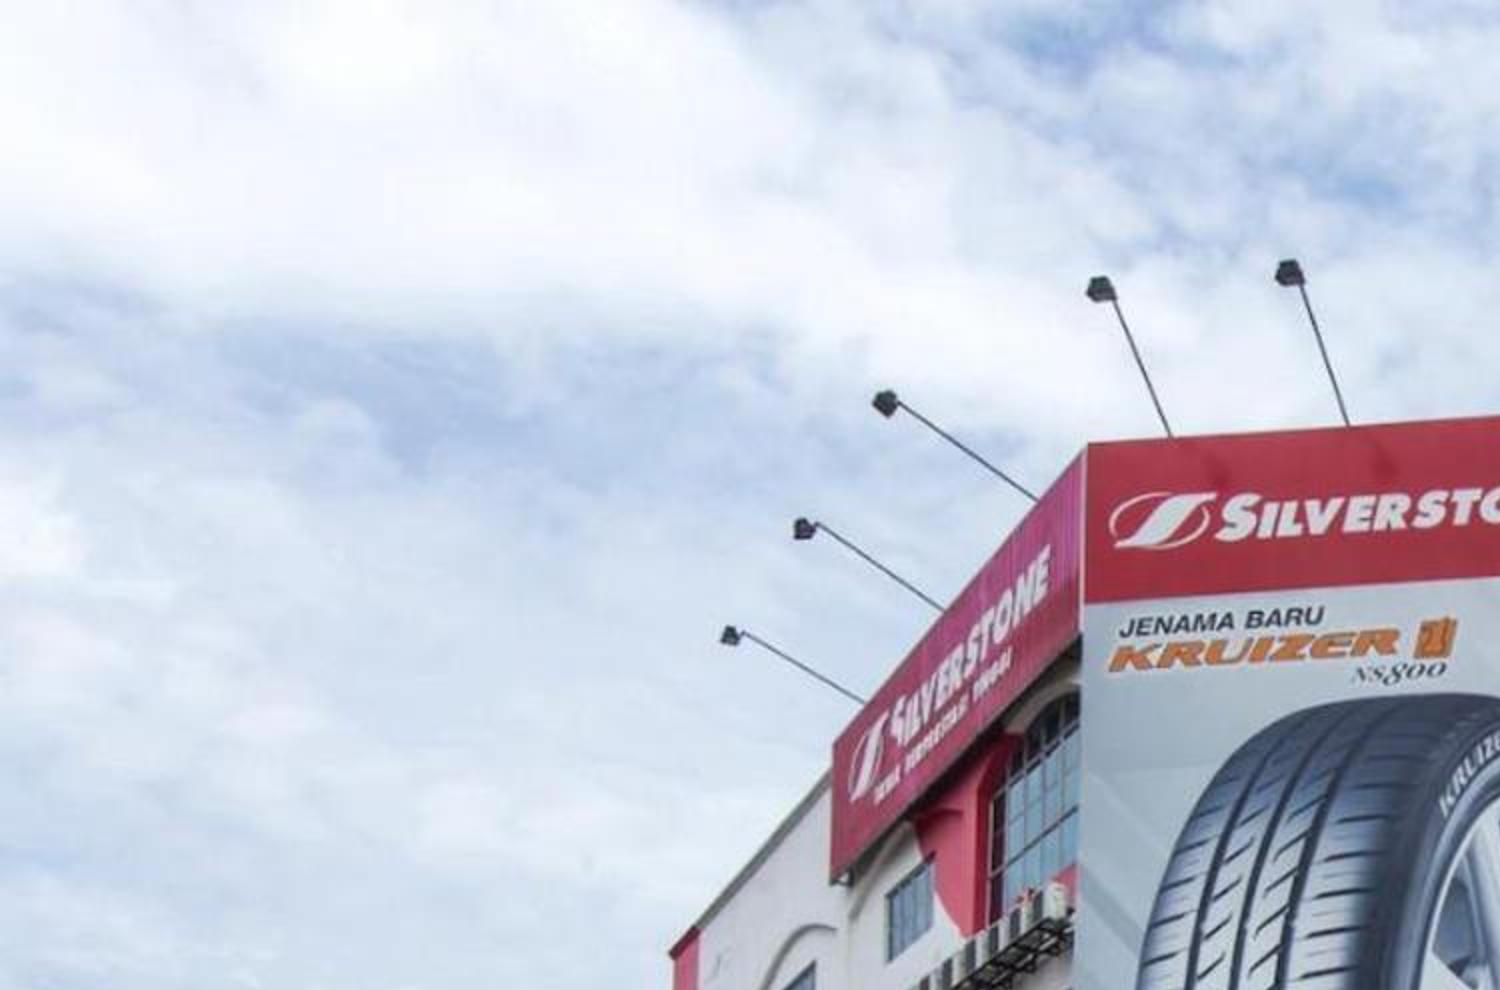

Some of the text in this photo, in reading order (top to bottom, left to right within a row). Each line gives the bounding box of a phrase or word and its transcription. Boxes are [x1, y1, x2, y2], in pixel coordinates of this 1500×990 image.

[1119, 606, 1325, 638] JENAMA BARU
[889, 543, 1051, 746] SILVERSTONE
[1109, 628, 1400, 673] KRUIZER
[1352, 662, 1446, 687] NS800
